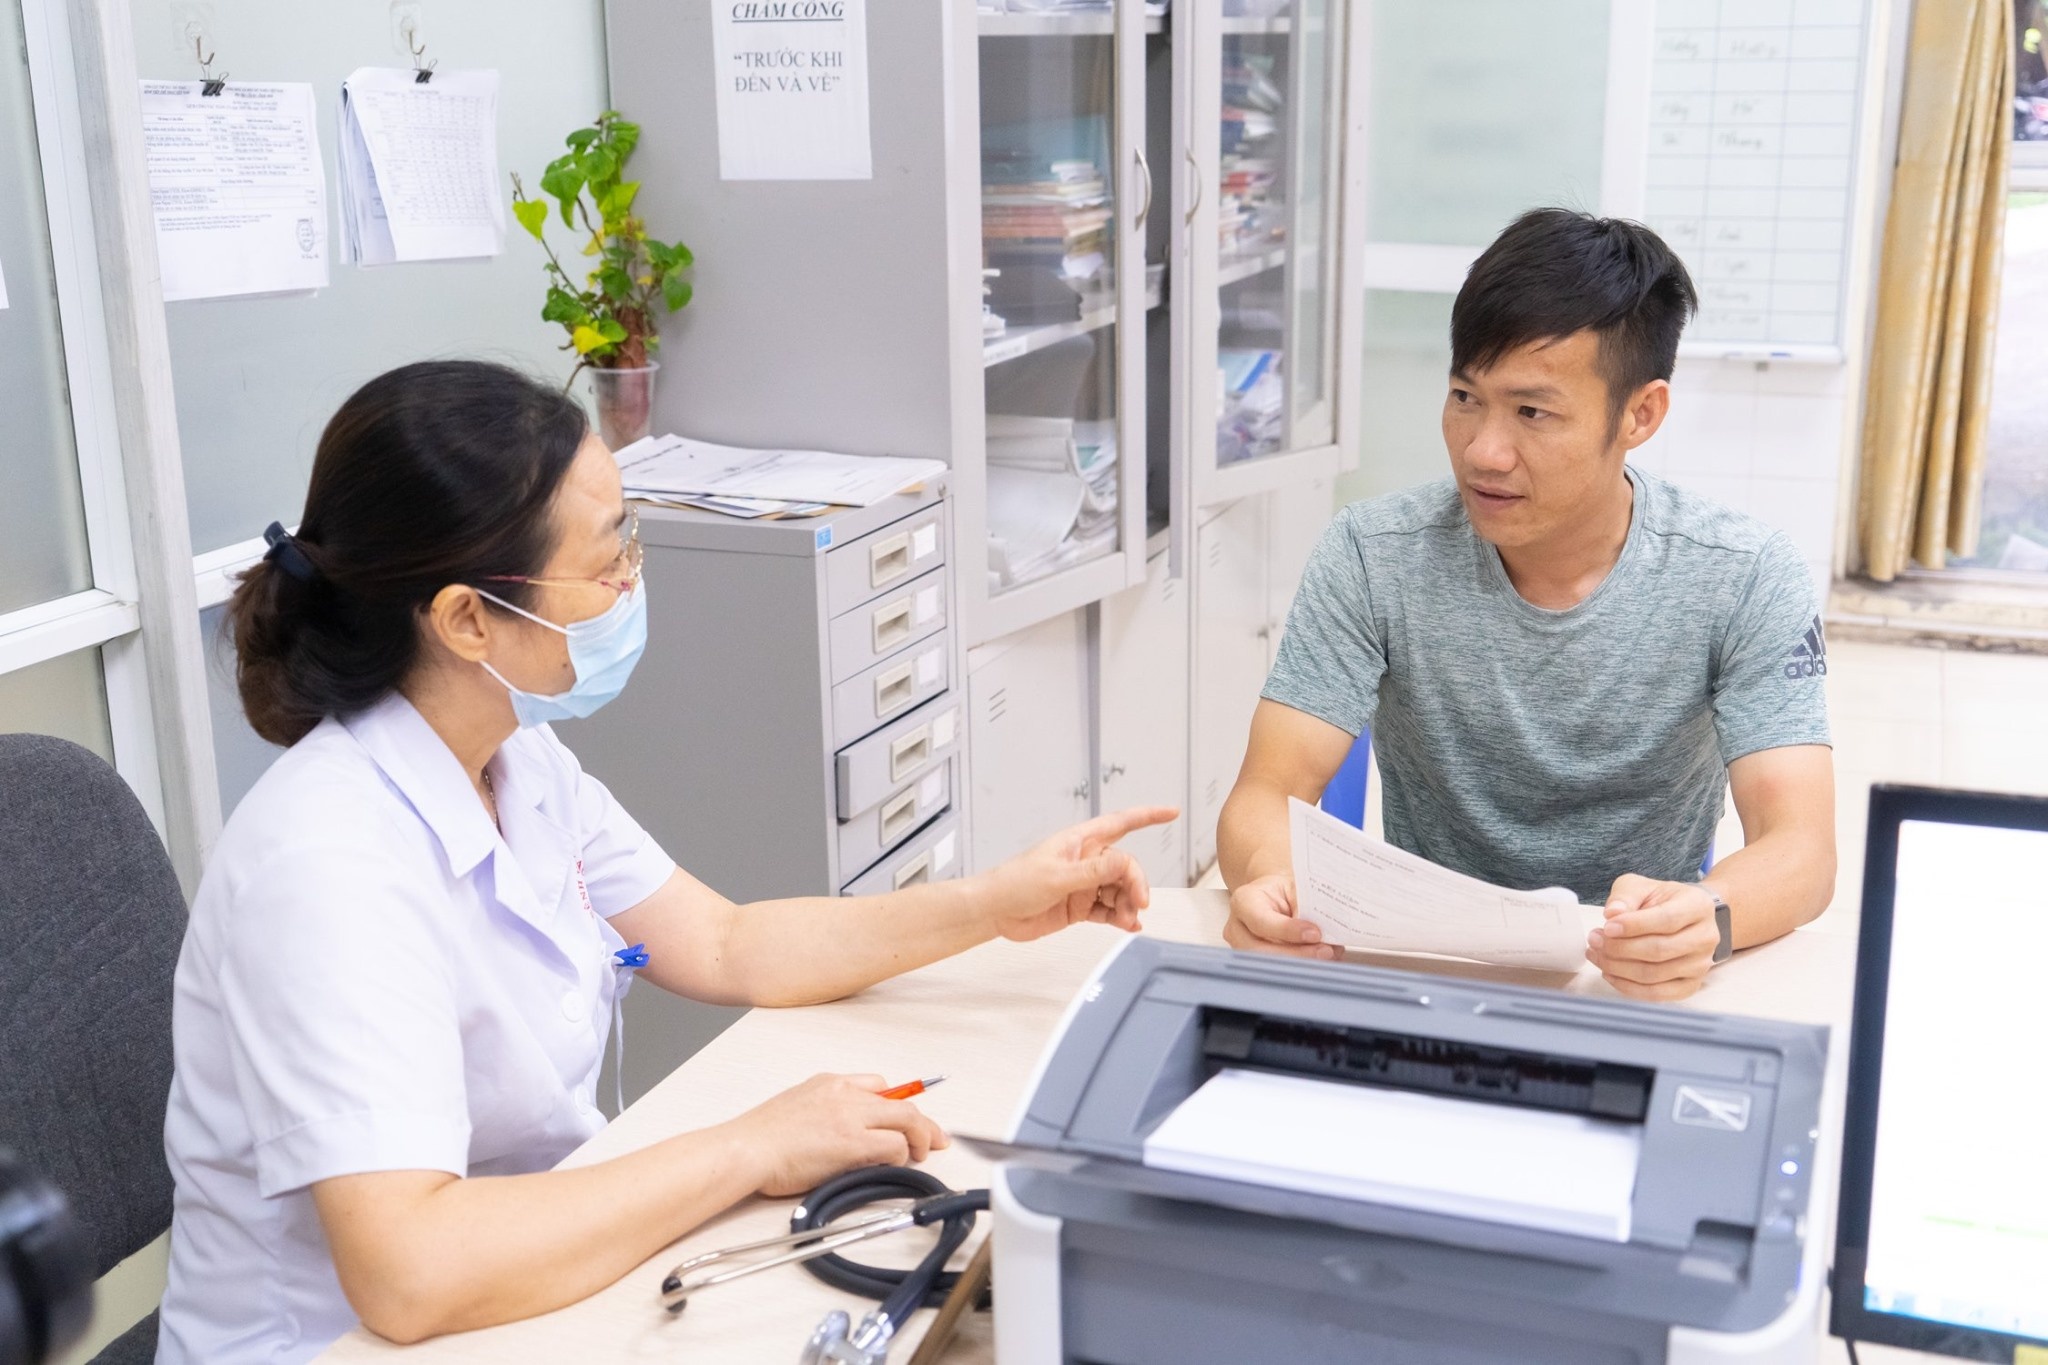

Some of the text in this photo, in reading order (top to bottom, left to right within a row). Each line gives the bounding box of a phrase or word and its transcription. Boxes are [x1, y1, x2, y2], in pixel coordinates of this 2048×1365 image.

[811, 51, 842, 67] KHI
[735, 72, 771, 92] ĐẾN
[777, 71, 802, 92] VÀ
